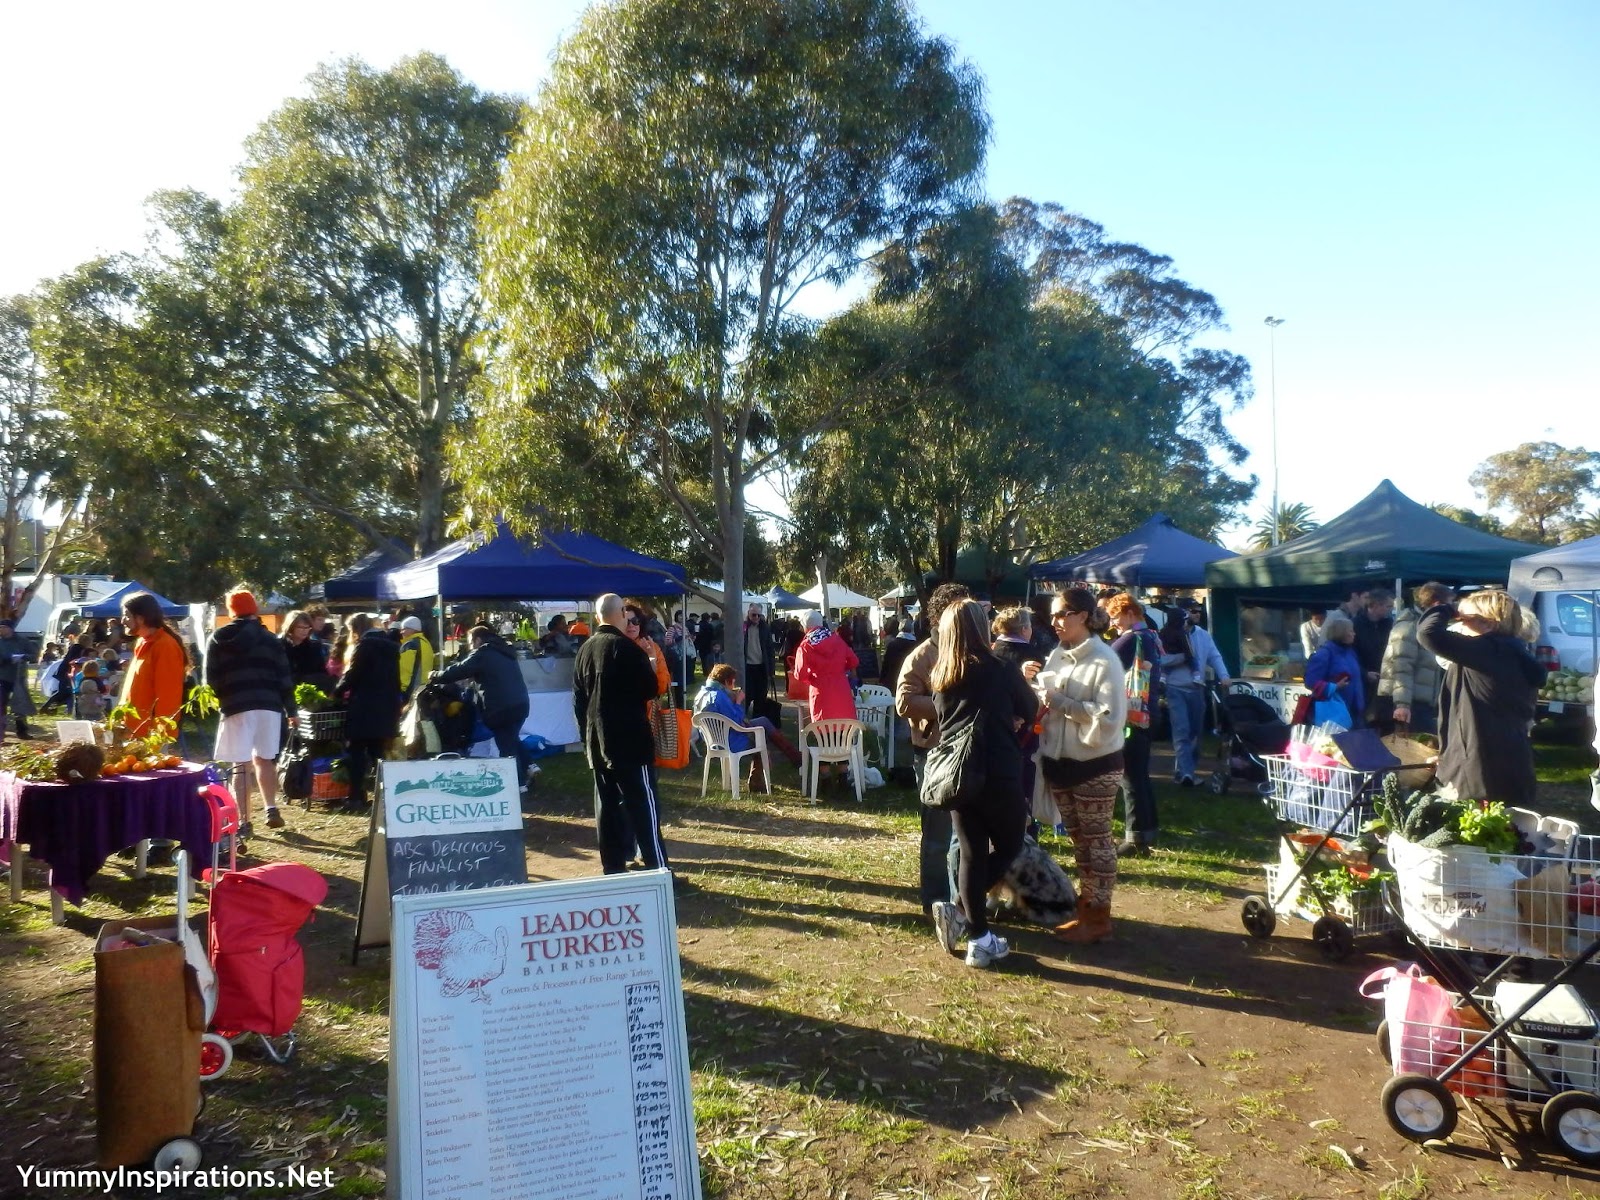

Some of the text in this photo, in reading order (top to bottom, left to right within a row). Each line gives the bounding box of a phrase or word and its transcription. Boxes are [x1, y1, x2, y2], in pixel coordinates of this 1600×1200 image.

[396, 801, 511, 824] GREENVALE
[393, 841, 424, 858] ABC
[407, 856, 490, 879] FINALIST
[523, 905, 640, 936] LEADOUX
[522, 929, 643, 961] TURKEYS
[524, 952, 644, 976] BAIRNSDALE
